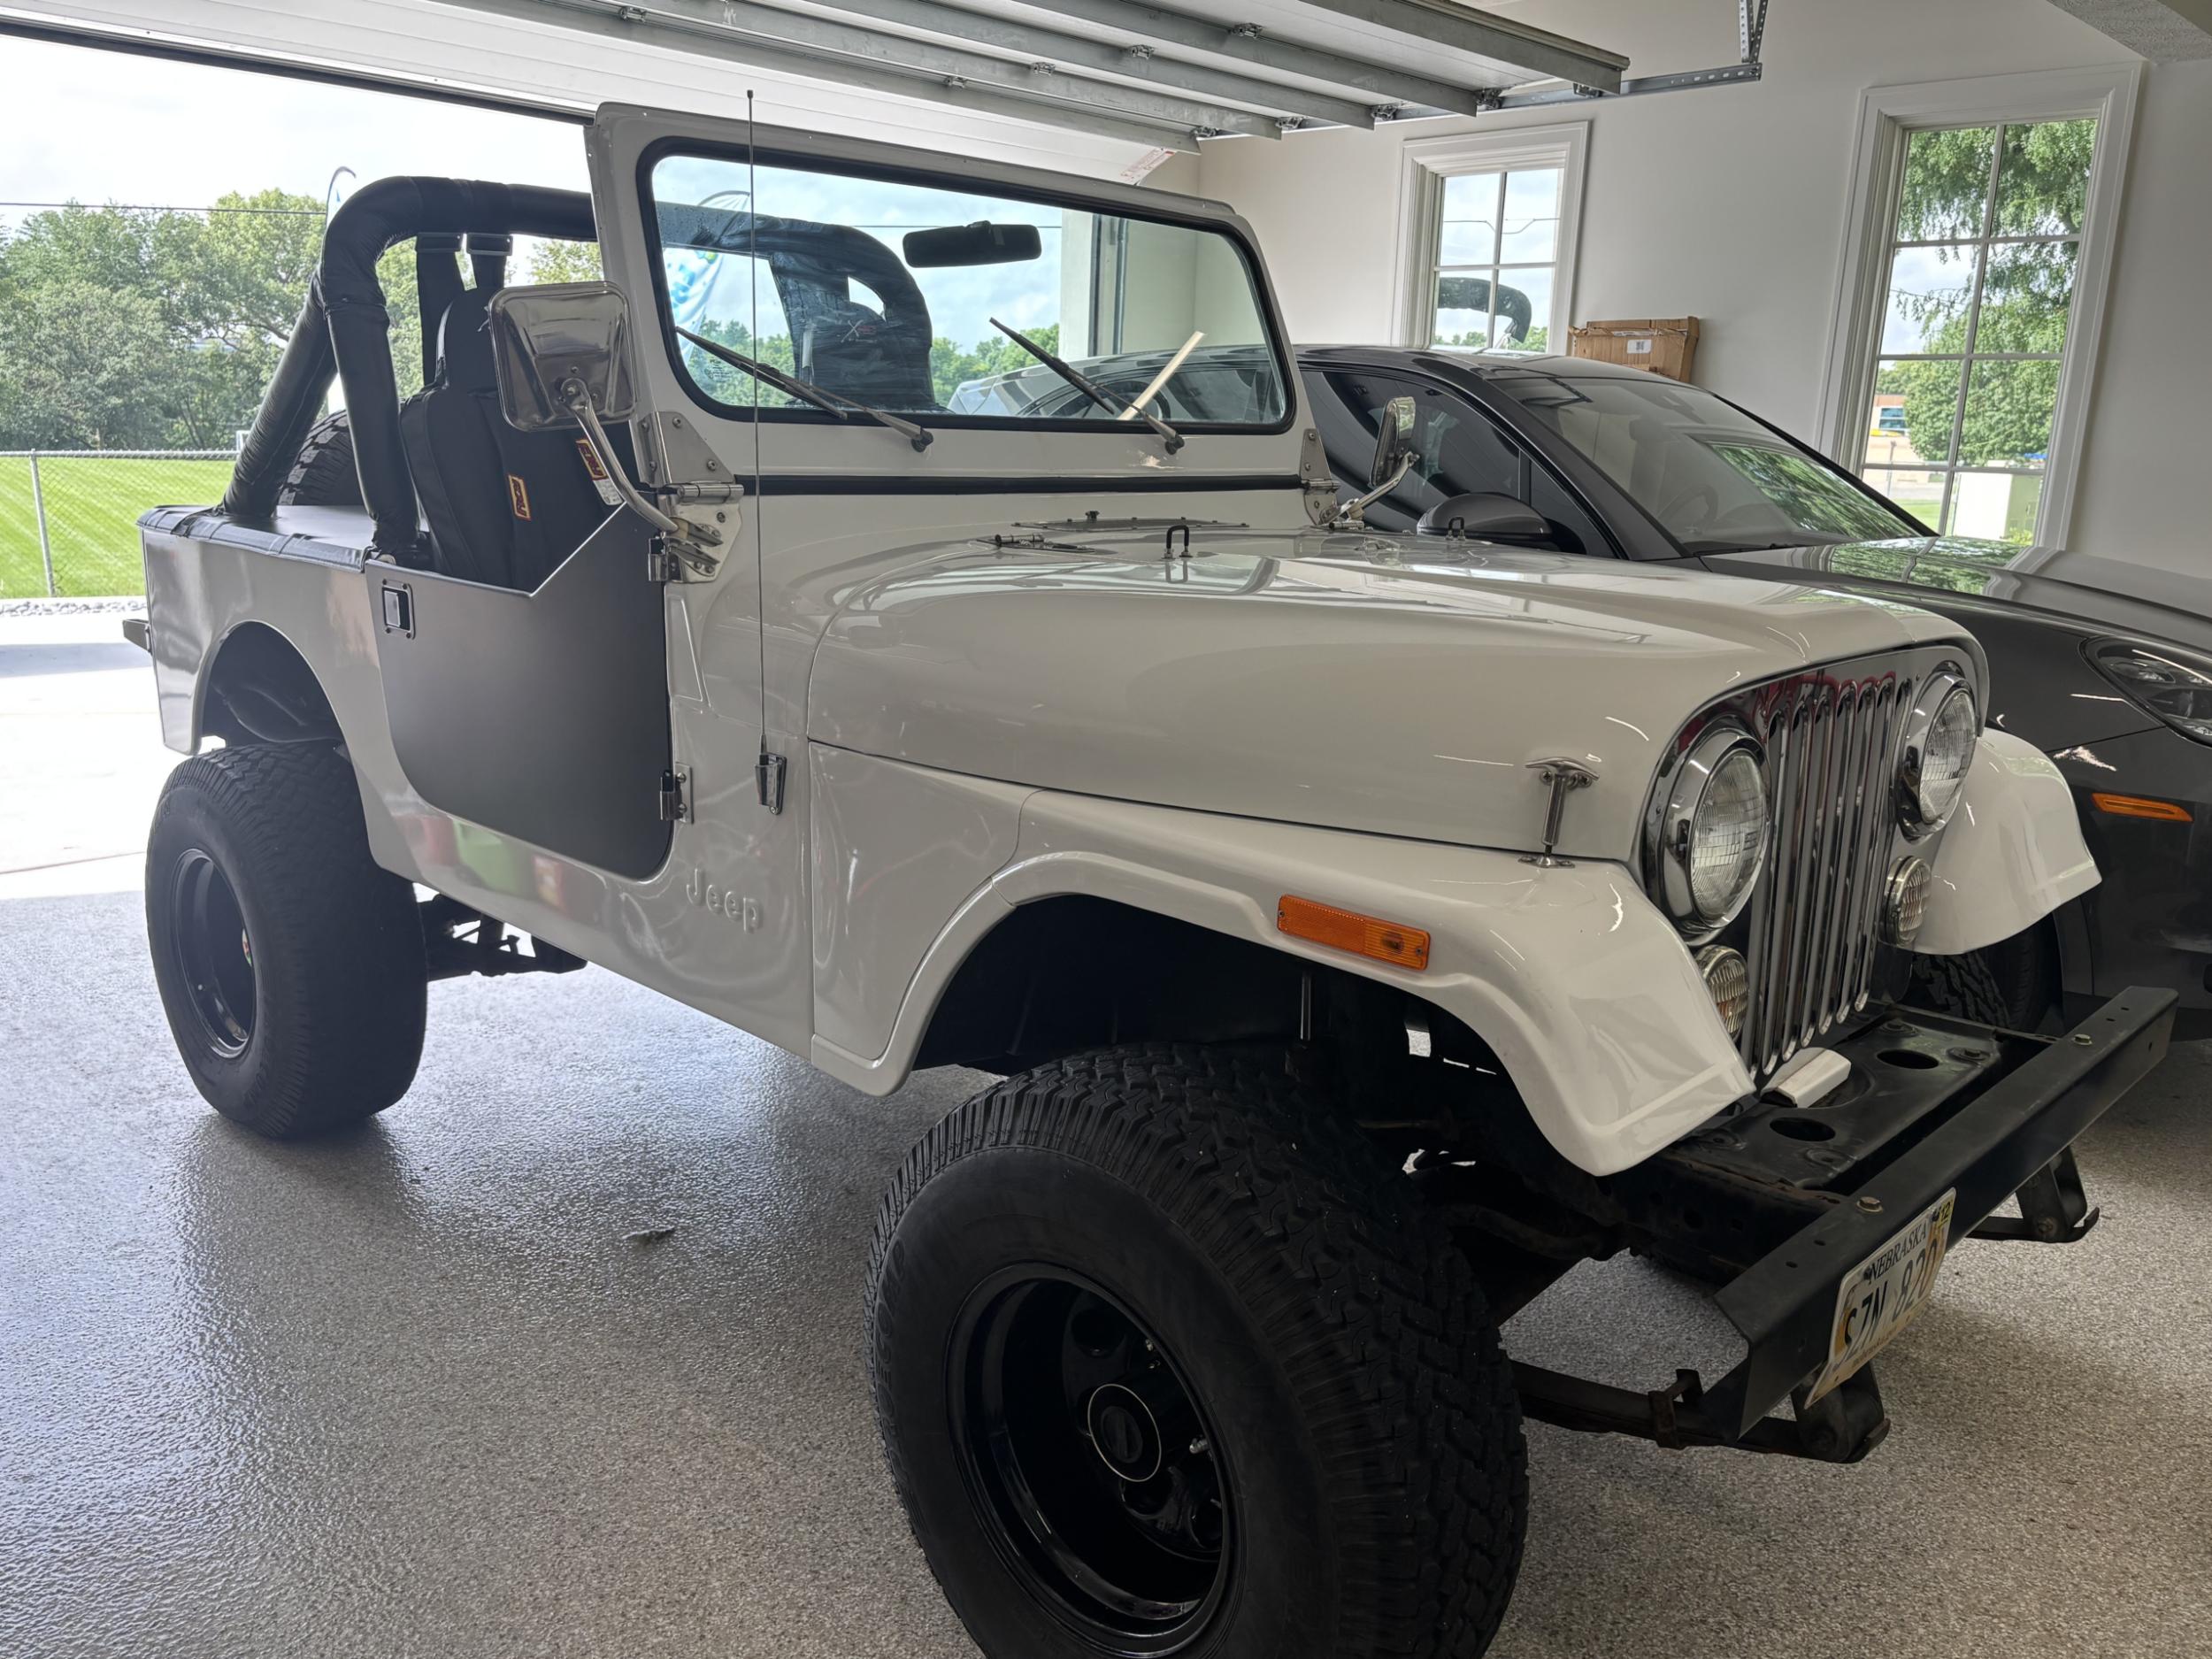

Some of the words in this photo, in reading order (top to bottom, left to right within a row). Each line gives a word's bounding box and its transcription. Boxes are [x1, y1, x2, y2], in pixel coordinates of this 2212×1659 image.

[686, 868, 764, 934] Jeep
[1869, 1223, 1927, 1284] NEBRASKA
[1892, 1238, 1938, 1323] 820
